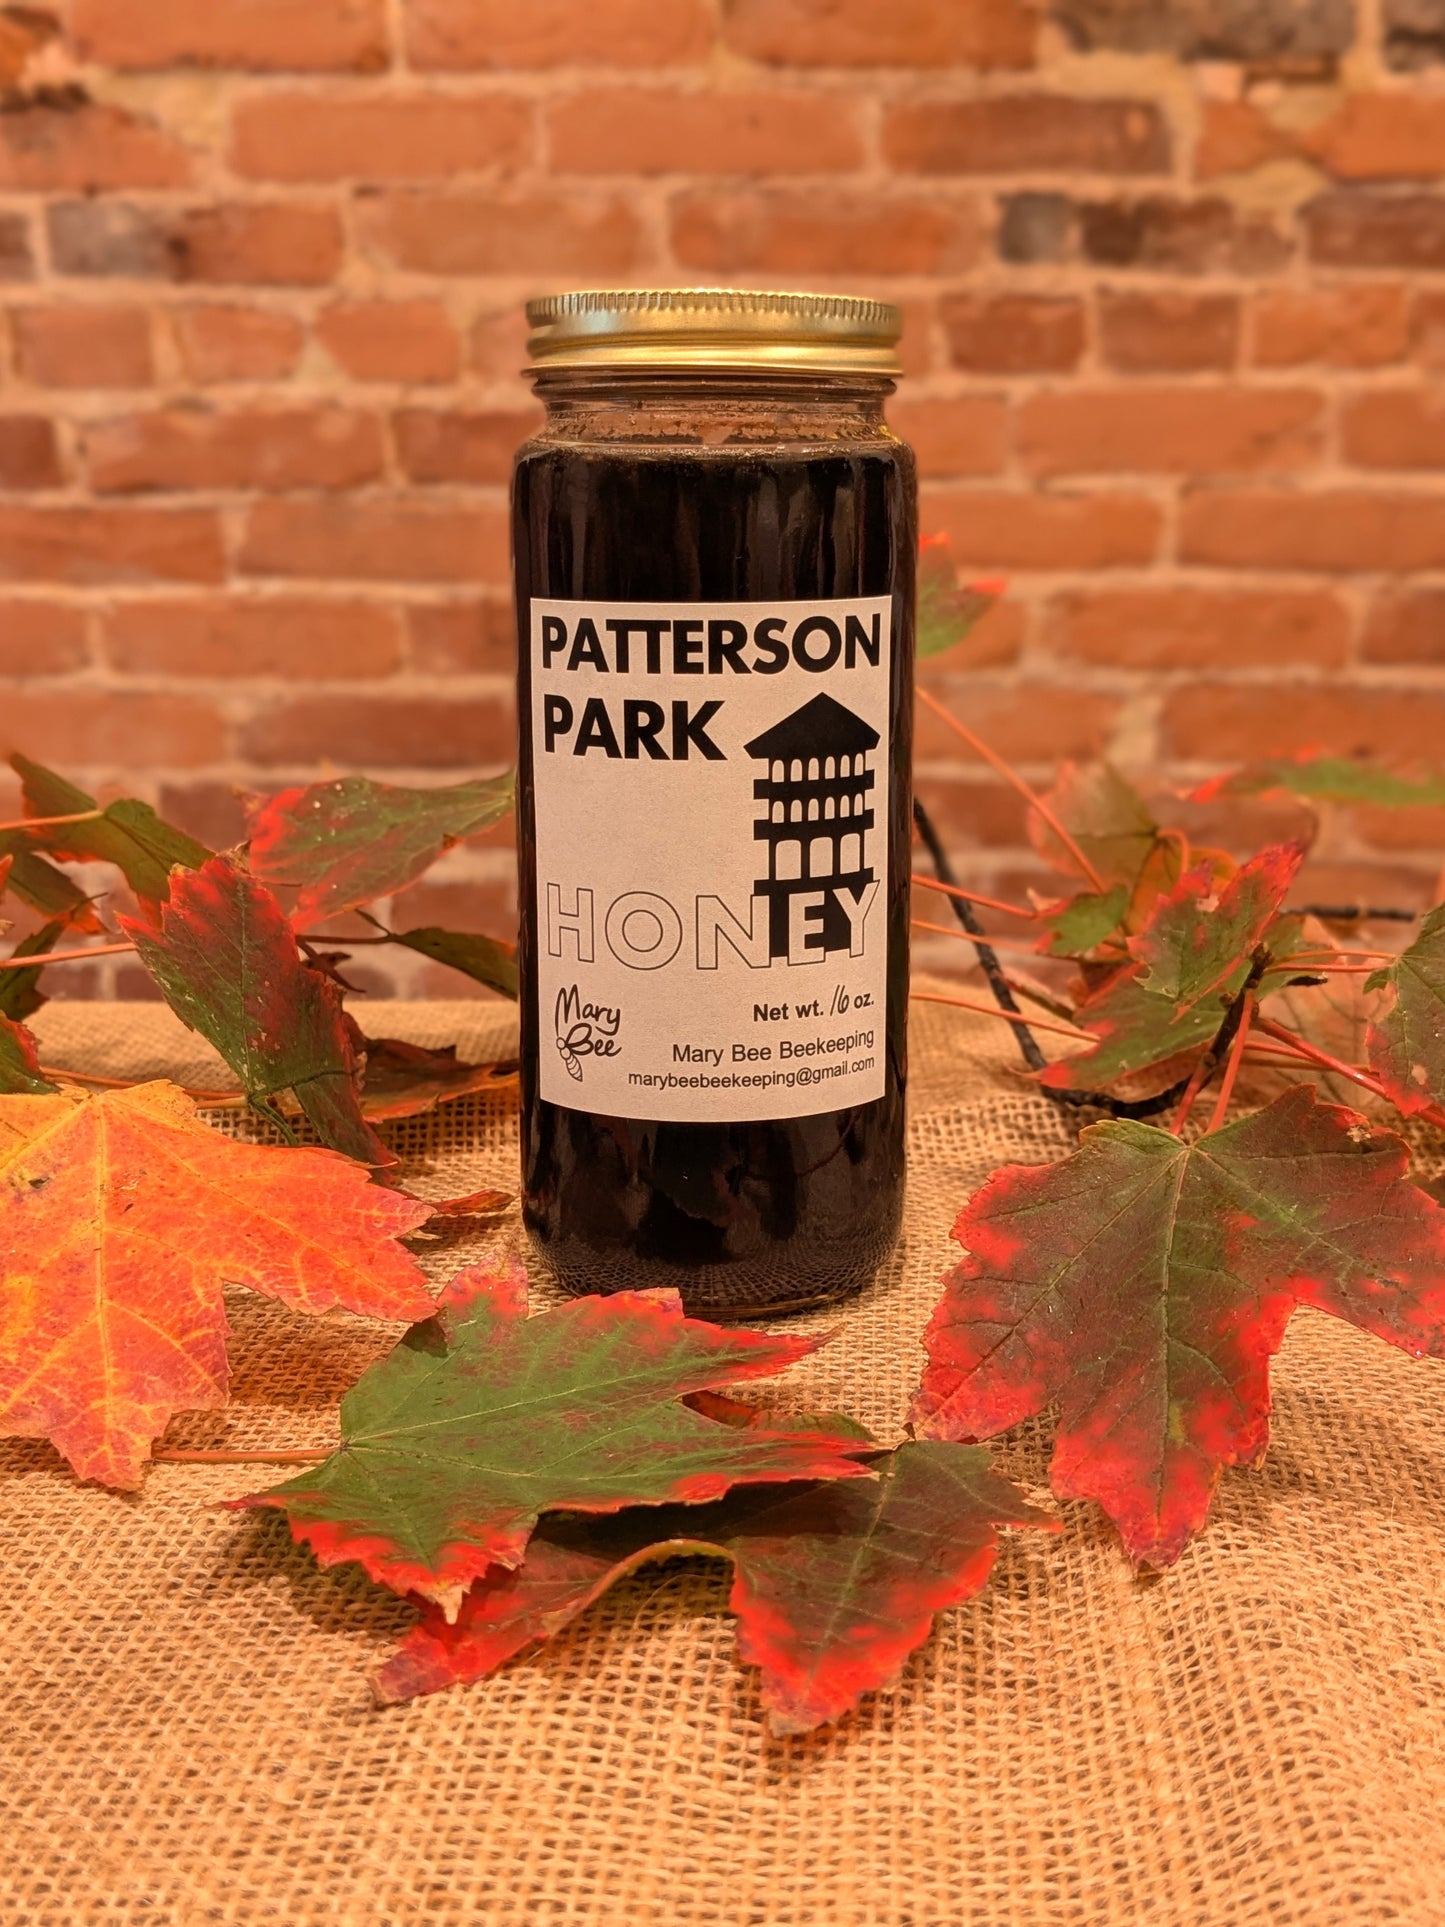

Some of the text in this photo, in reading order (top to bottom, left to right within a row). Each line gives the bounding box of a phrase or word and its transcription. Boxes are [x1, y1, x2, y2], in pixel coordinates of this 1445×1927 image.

[542, 613, 881, 674] PATTERSON
[544, 694, 728, 761] PARK
[547, 879, 881, 970] HONEY
[555, 984, 621, 1036] Mary
[753, 984, 875, 1022] Net wt. 16 oz.
[564, 1023, 622, 1057] Bee
[672, 1028, 875, 1067] Mary Bee Beekeeping
[628, 1056, 875, 1091] marybeebeekeeping@gmail.com
